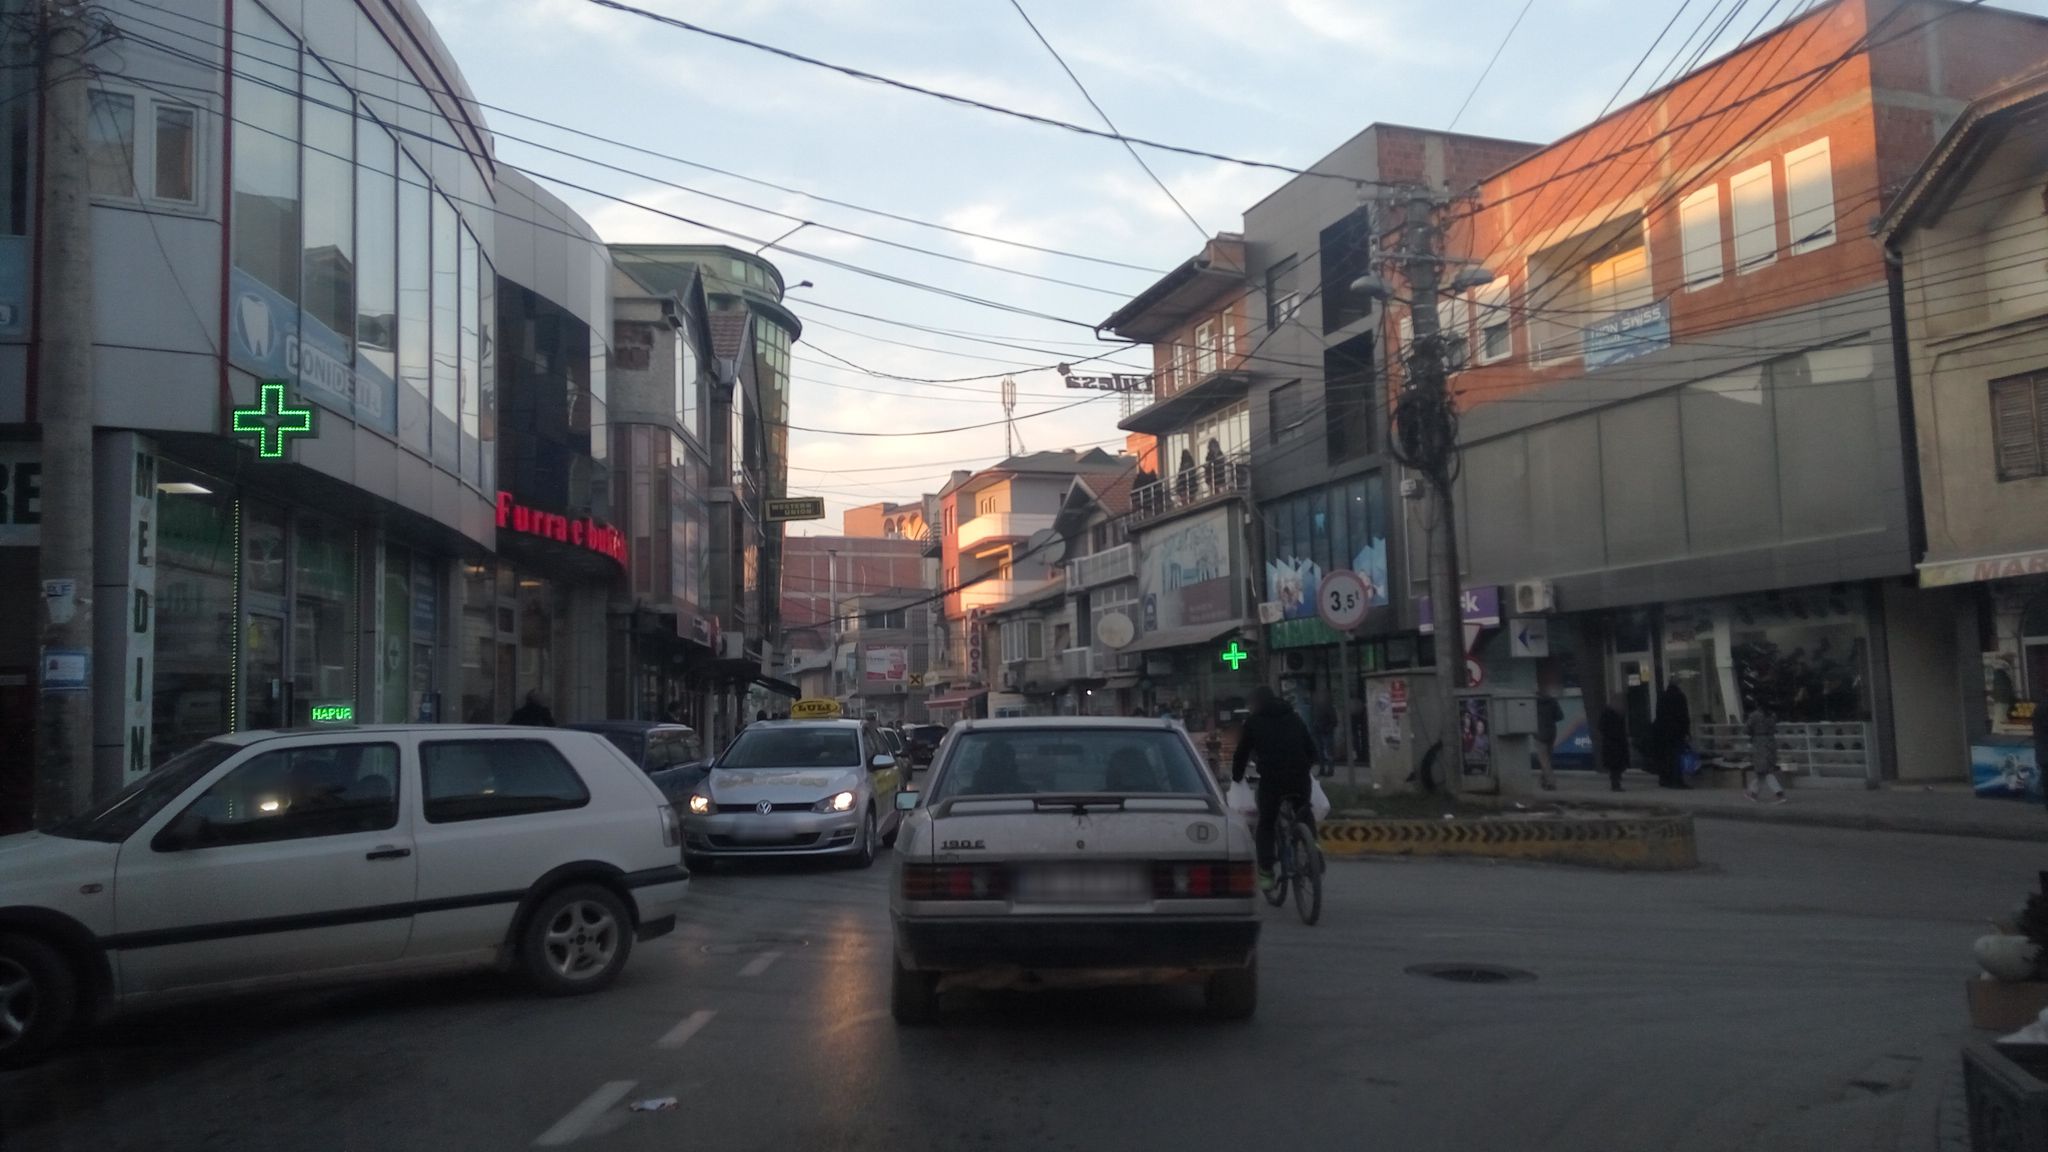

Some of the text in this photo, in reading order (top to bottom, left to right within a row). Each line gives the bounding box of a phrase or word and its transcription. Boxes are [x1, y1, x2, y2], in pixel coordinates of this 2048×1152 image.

[1622, 308, 1661, 331] SWISS
[496, 490, 568, 543] Furra
[571, 518, 583, 545] e
[1196, 825, 1209, 841] D
